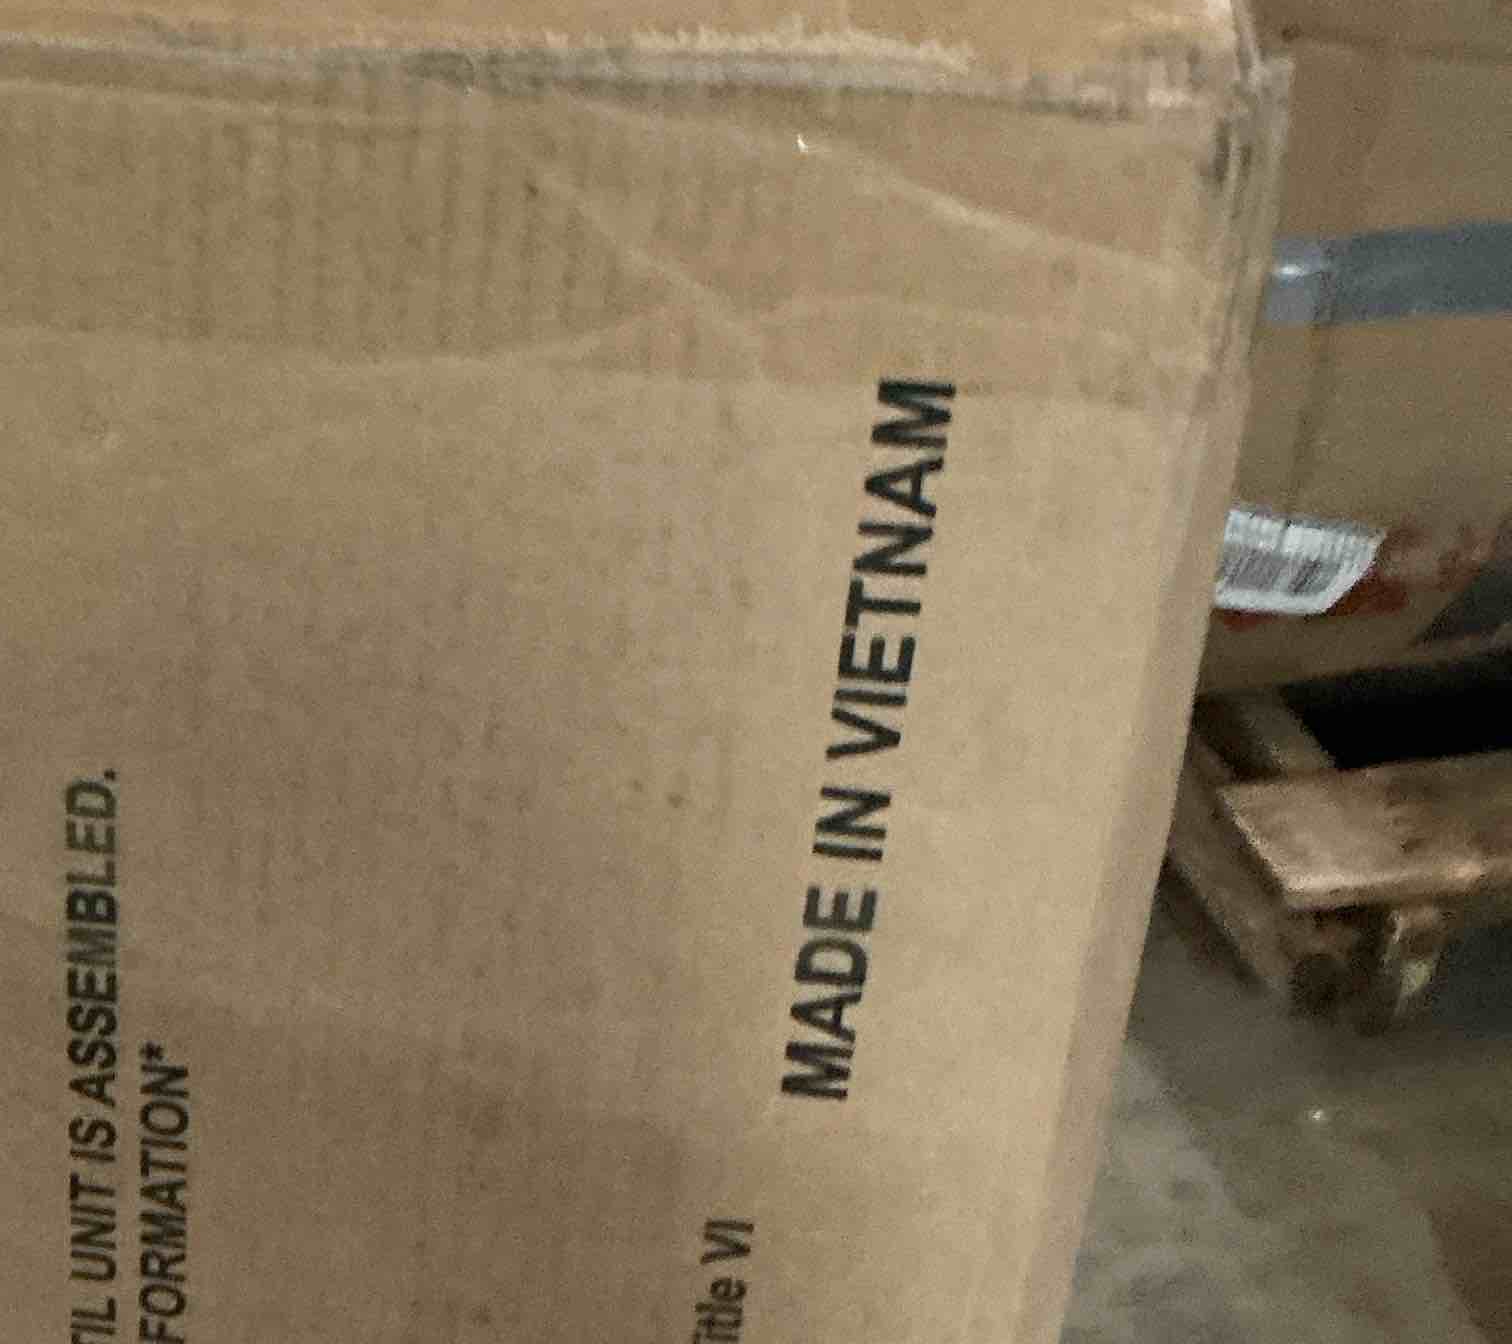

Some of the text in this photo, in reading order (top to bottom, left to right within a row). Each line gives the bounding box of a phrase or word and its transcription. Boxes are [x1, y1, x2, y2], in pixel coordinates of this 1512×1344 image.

[779, 376, 957, 1101] MADE IN VIETNAM
[64, 767, 119, 1105] ASSEMBLED.
[68, 1116, 118, 1164] IS
[69, 1174, 119, 1282] UNIT
[700, 1216, 754, 1264] VI
